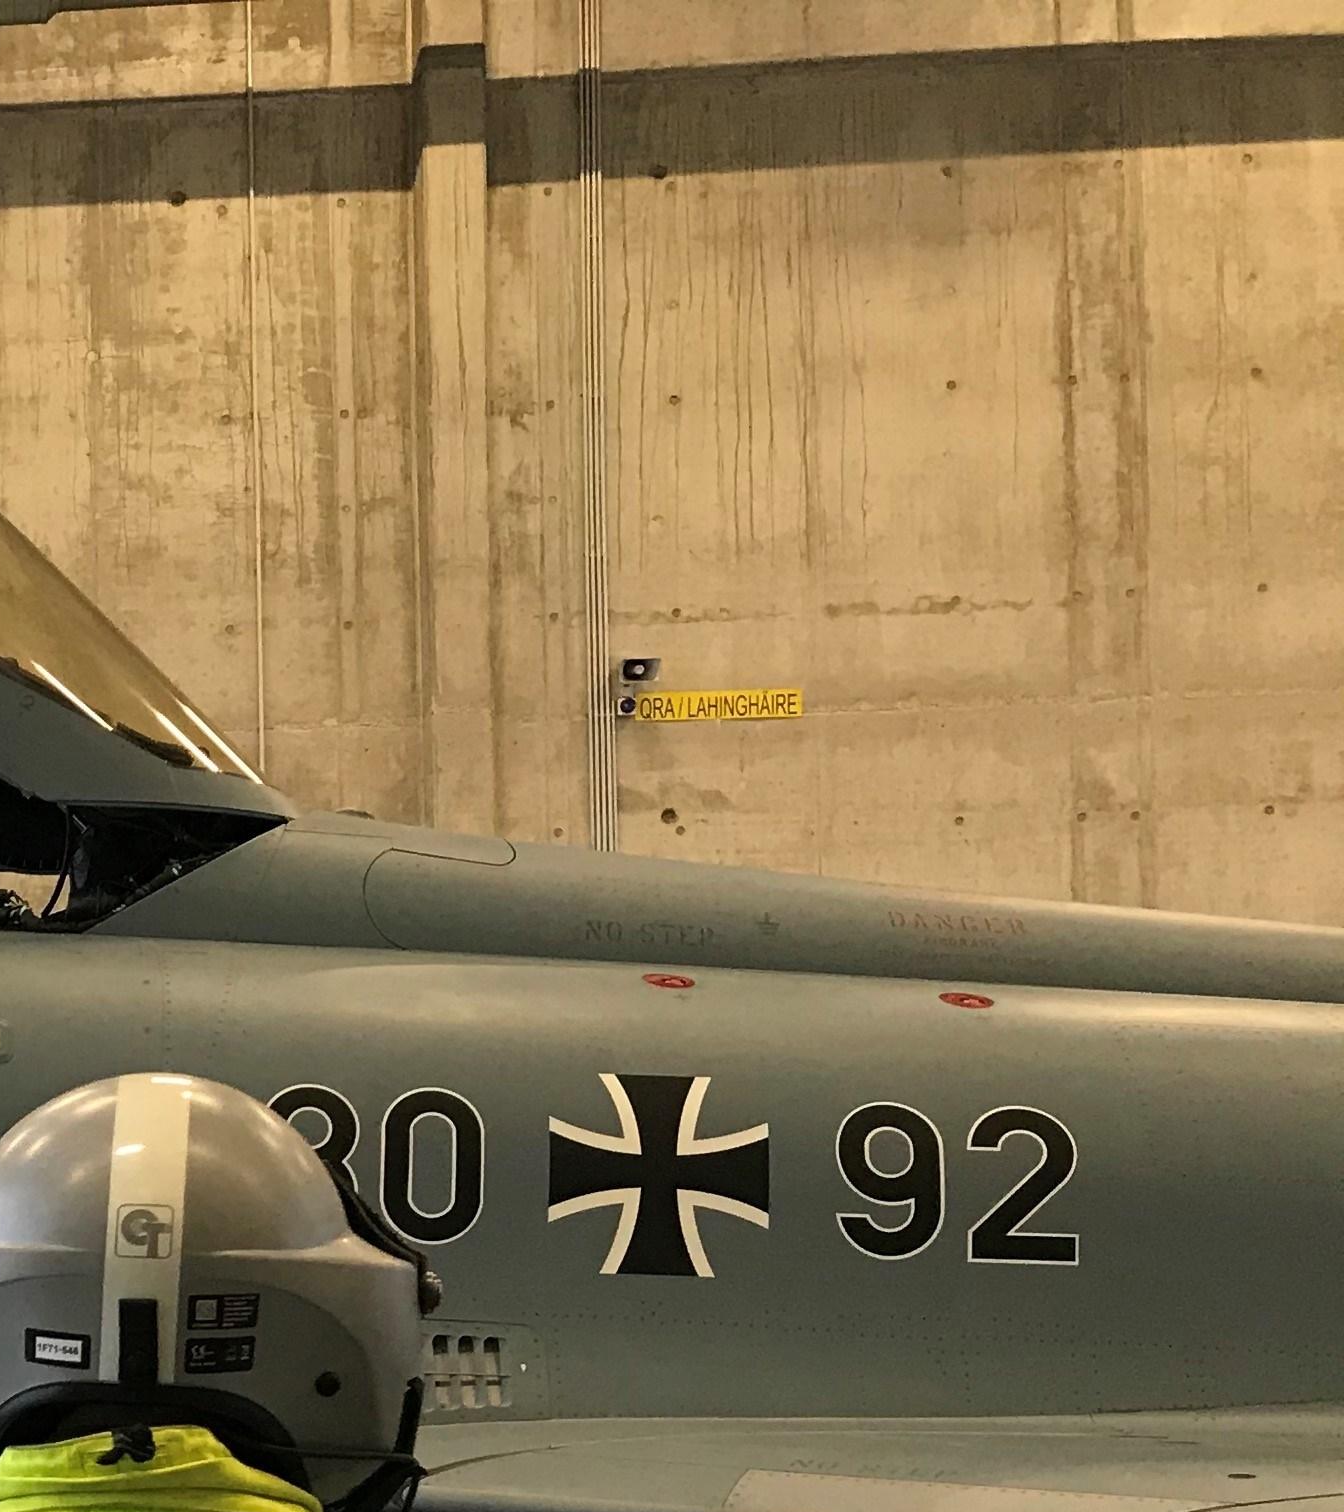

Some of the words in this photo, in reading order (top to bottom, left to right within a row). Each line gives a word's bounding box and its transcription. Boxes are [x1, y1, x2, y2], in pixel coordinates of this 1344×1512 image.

[639, 696, 675, 719] QRA
[677, 696, 684, 717] /
[687, 690, 798, 717] LAHINGHÄIRE
[585, 919, 623, 941] NO
[640, 922, 715, 947] STEP
[887, 911, 1025, 935] DANGER
[835, 1101, 1079, 1266] 92
